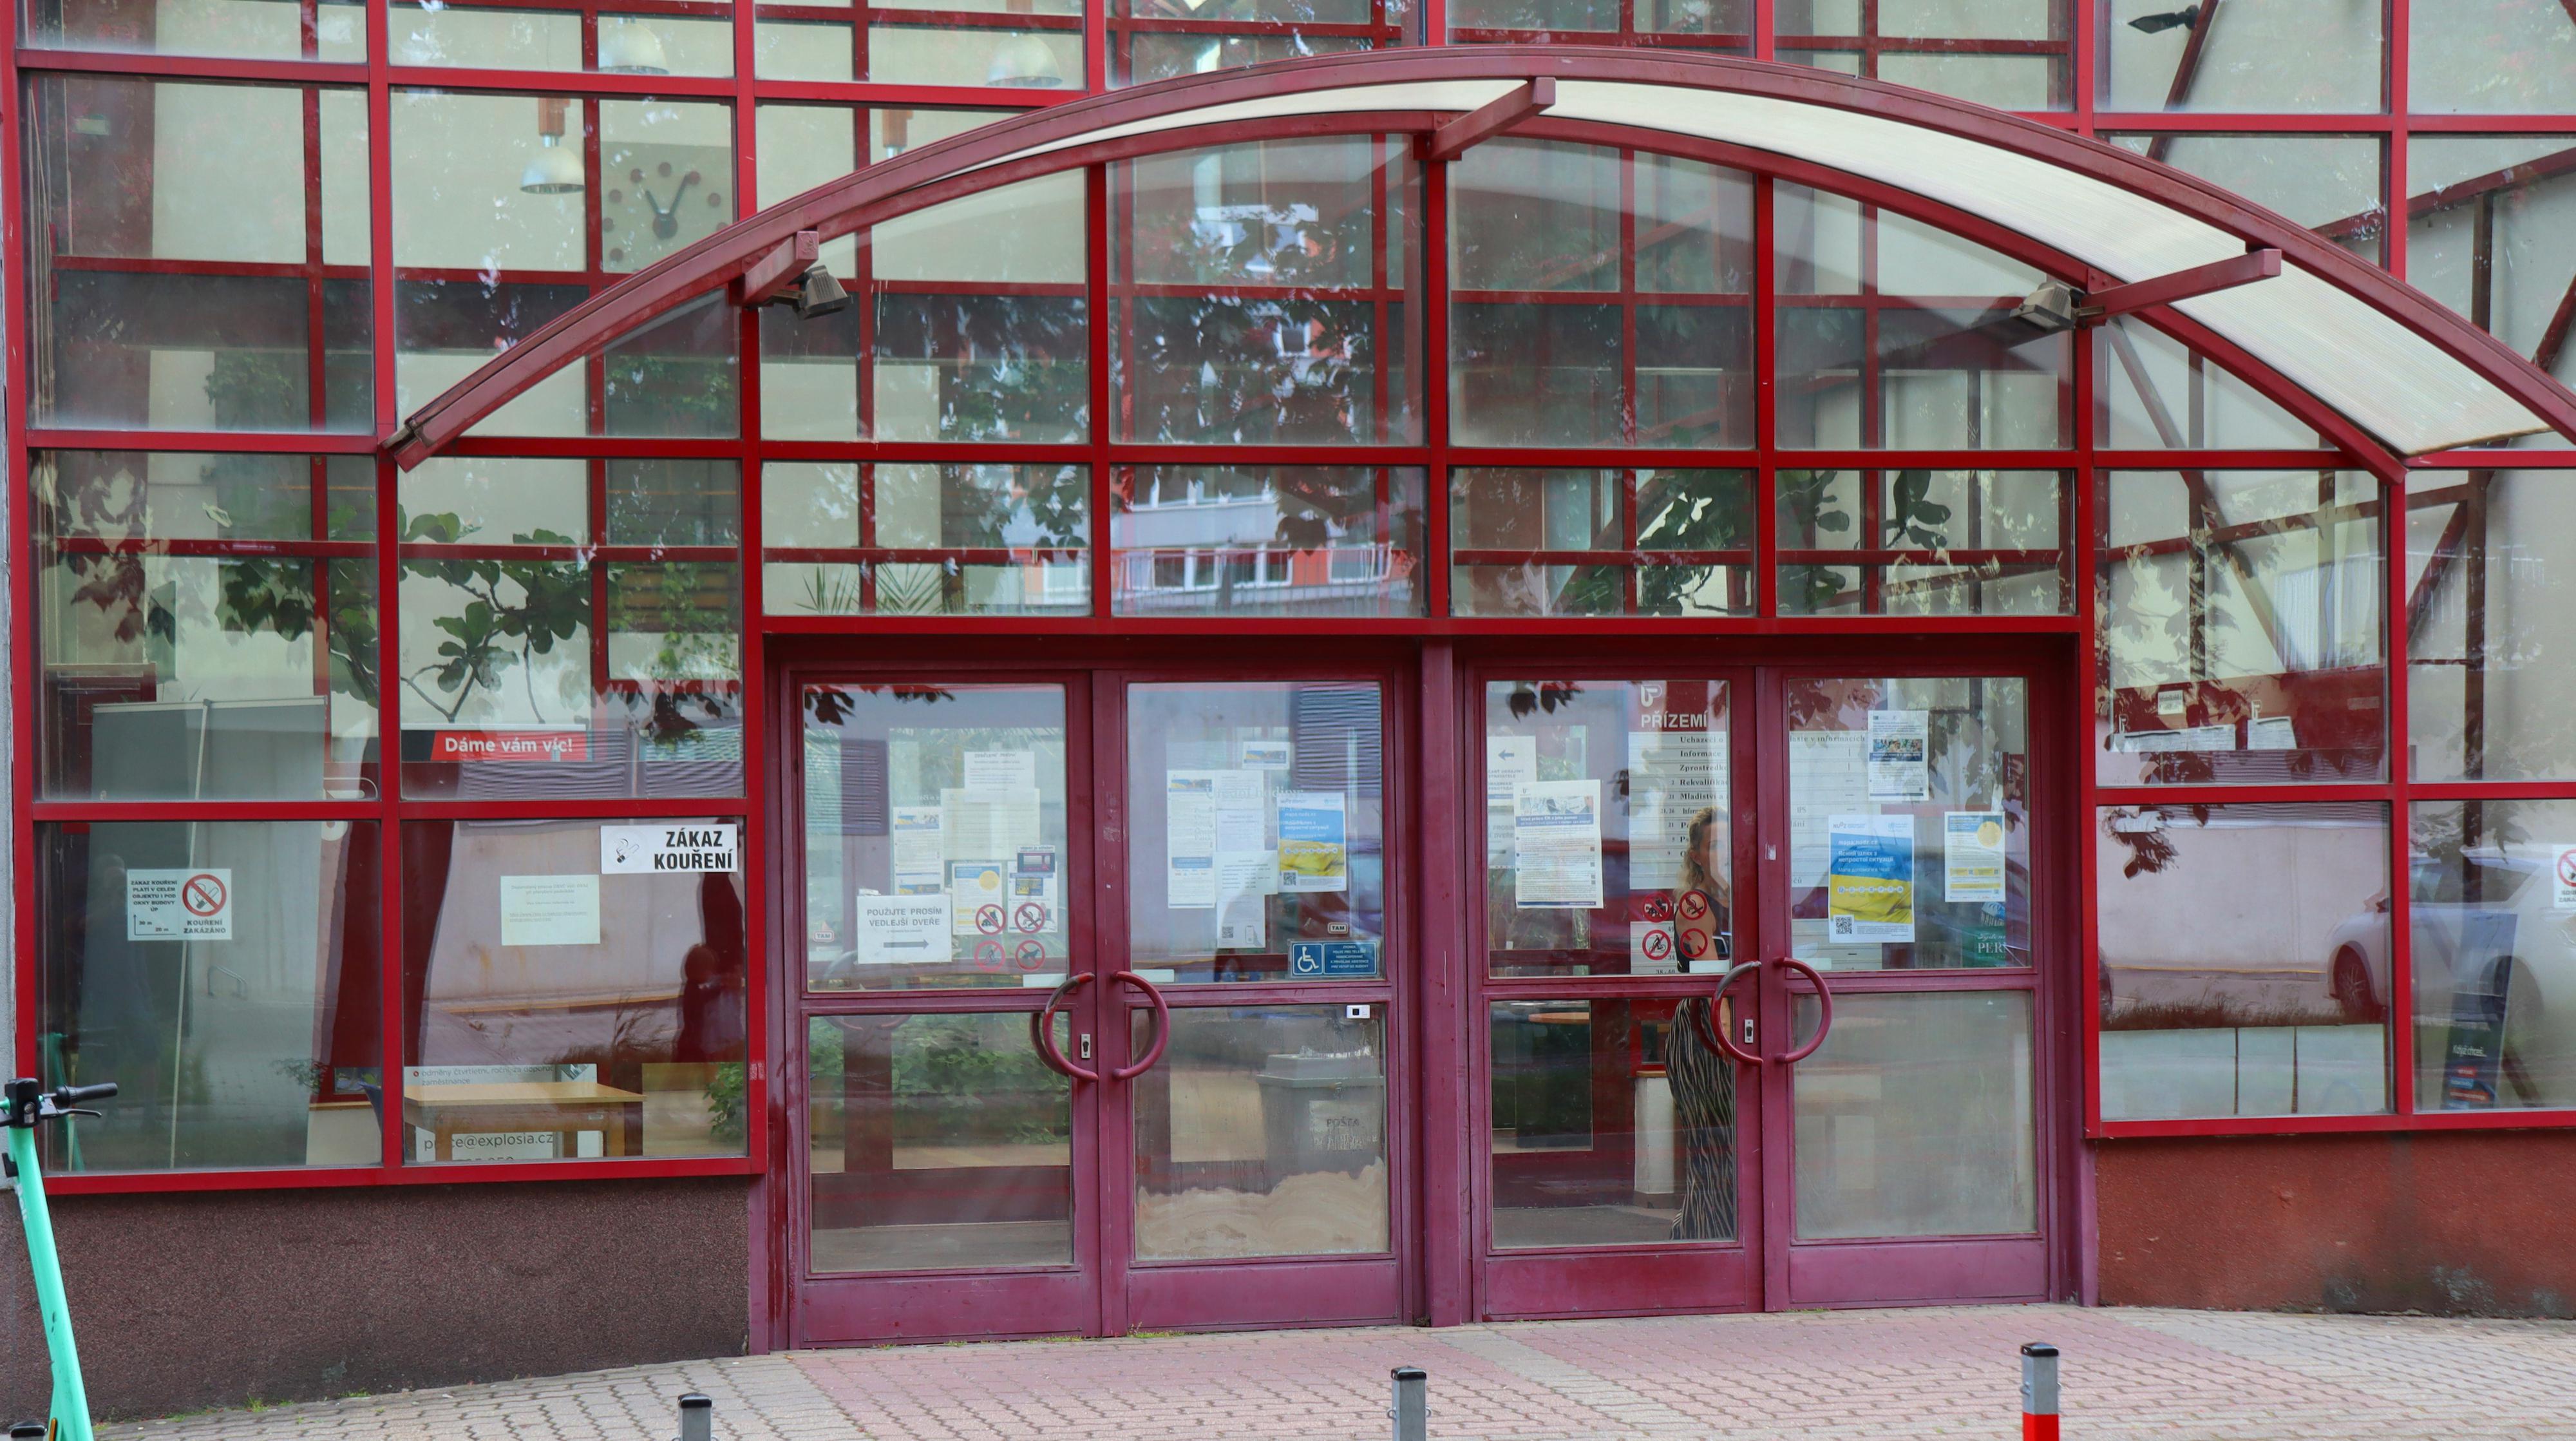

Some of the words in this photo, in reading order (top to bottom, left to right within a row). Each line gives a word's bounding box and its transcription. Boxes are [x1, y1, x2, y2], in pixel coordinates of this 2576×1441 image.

[1641, 710, 1708, 728] PŘÍZEMÍ
[445, 737, 495, 752] Dáme
[501, 737, 537, 752] vám
[543, 737, 573, 752] víc!
[666, 828, 723, 847] ZÁKAZ
[654, 849, 733, 870] KOUŘENÍ
[867, 907, 906, 916] POUŽIJTE
[911, 907, 942, 915] PROSÍM
[869, 918, 908, 927] VEDLEJŠÍ
[913, 917, 940, 926] DVEŘE
[422, 1078, 470, 1087] zaměstnance
[424, 1132, 553, 1151] pe@explosia.cz
